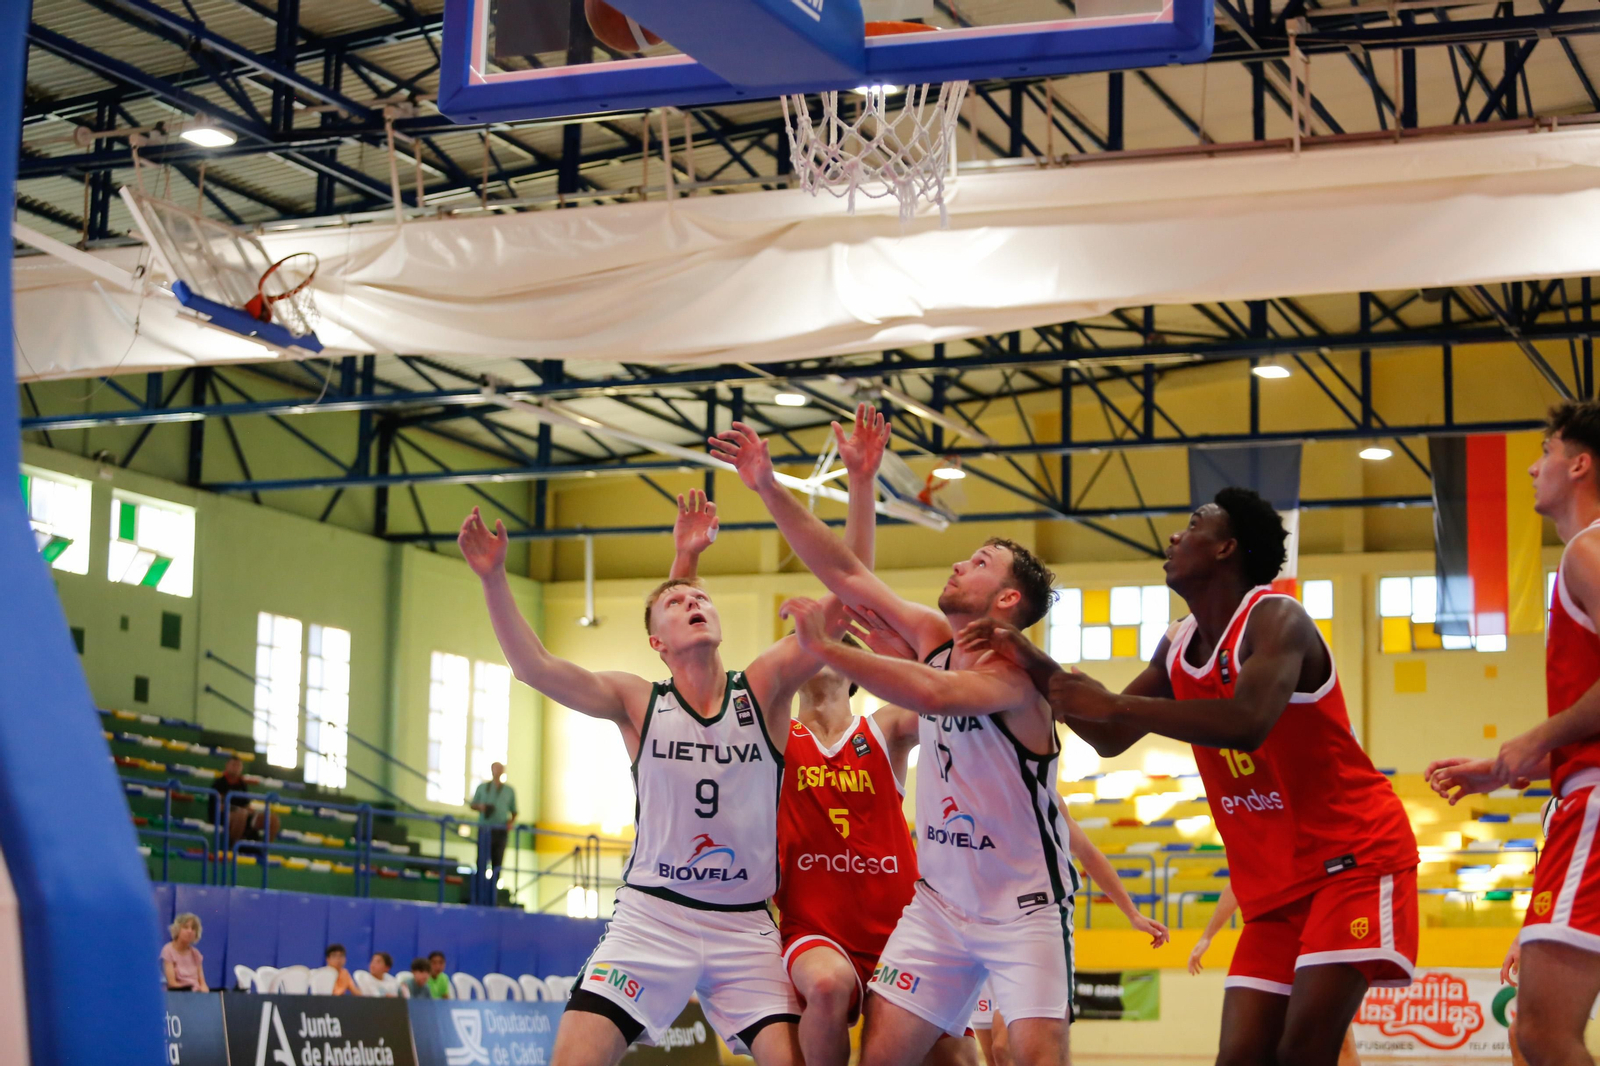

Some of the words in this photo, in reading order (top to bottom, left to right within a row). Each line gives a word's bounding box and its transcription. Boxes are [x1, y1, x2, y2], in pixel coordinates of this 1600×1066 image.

[652, 739, 763, 764] LIETUVA
[1219, 748, 1255, 778] 16
[797, 765, 876, 795] ESPAÑA
[694, 778, 719, 819] 9
[828, 808, 850, 839] 5
[659, 863, 748, 881] BIOVELA
[797, 849, 899, 874] endesa
[608, 968, 645, 1003] MSI
[879, 966, 920, 994] MSI
[1363, 976, 1464, 1004] mpañía
[299, 1011, 342, 1038] Junta
[485, 1009, 551, 1037] Diputación
[301, 1040, 322, 1066] de
[324, 1037, 394, 1066] Andalucía
[658, 1027, 695, 1053] ajasur
[493, 1043, 509, 1066] de
